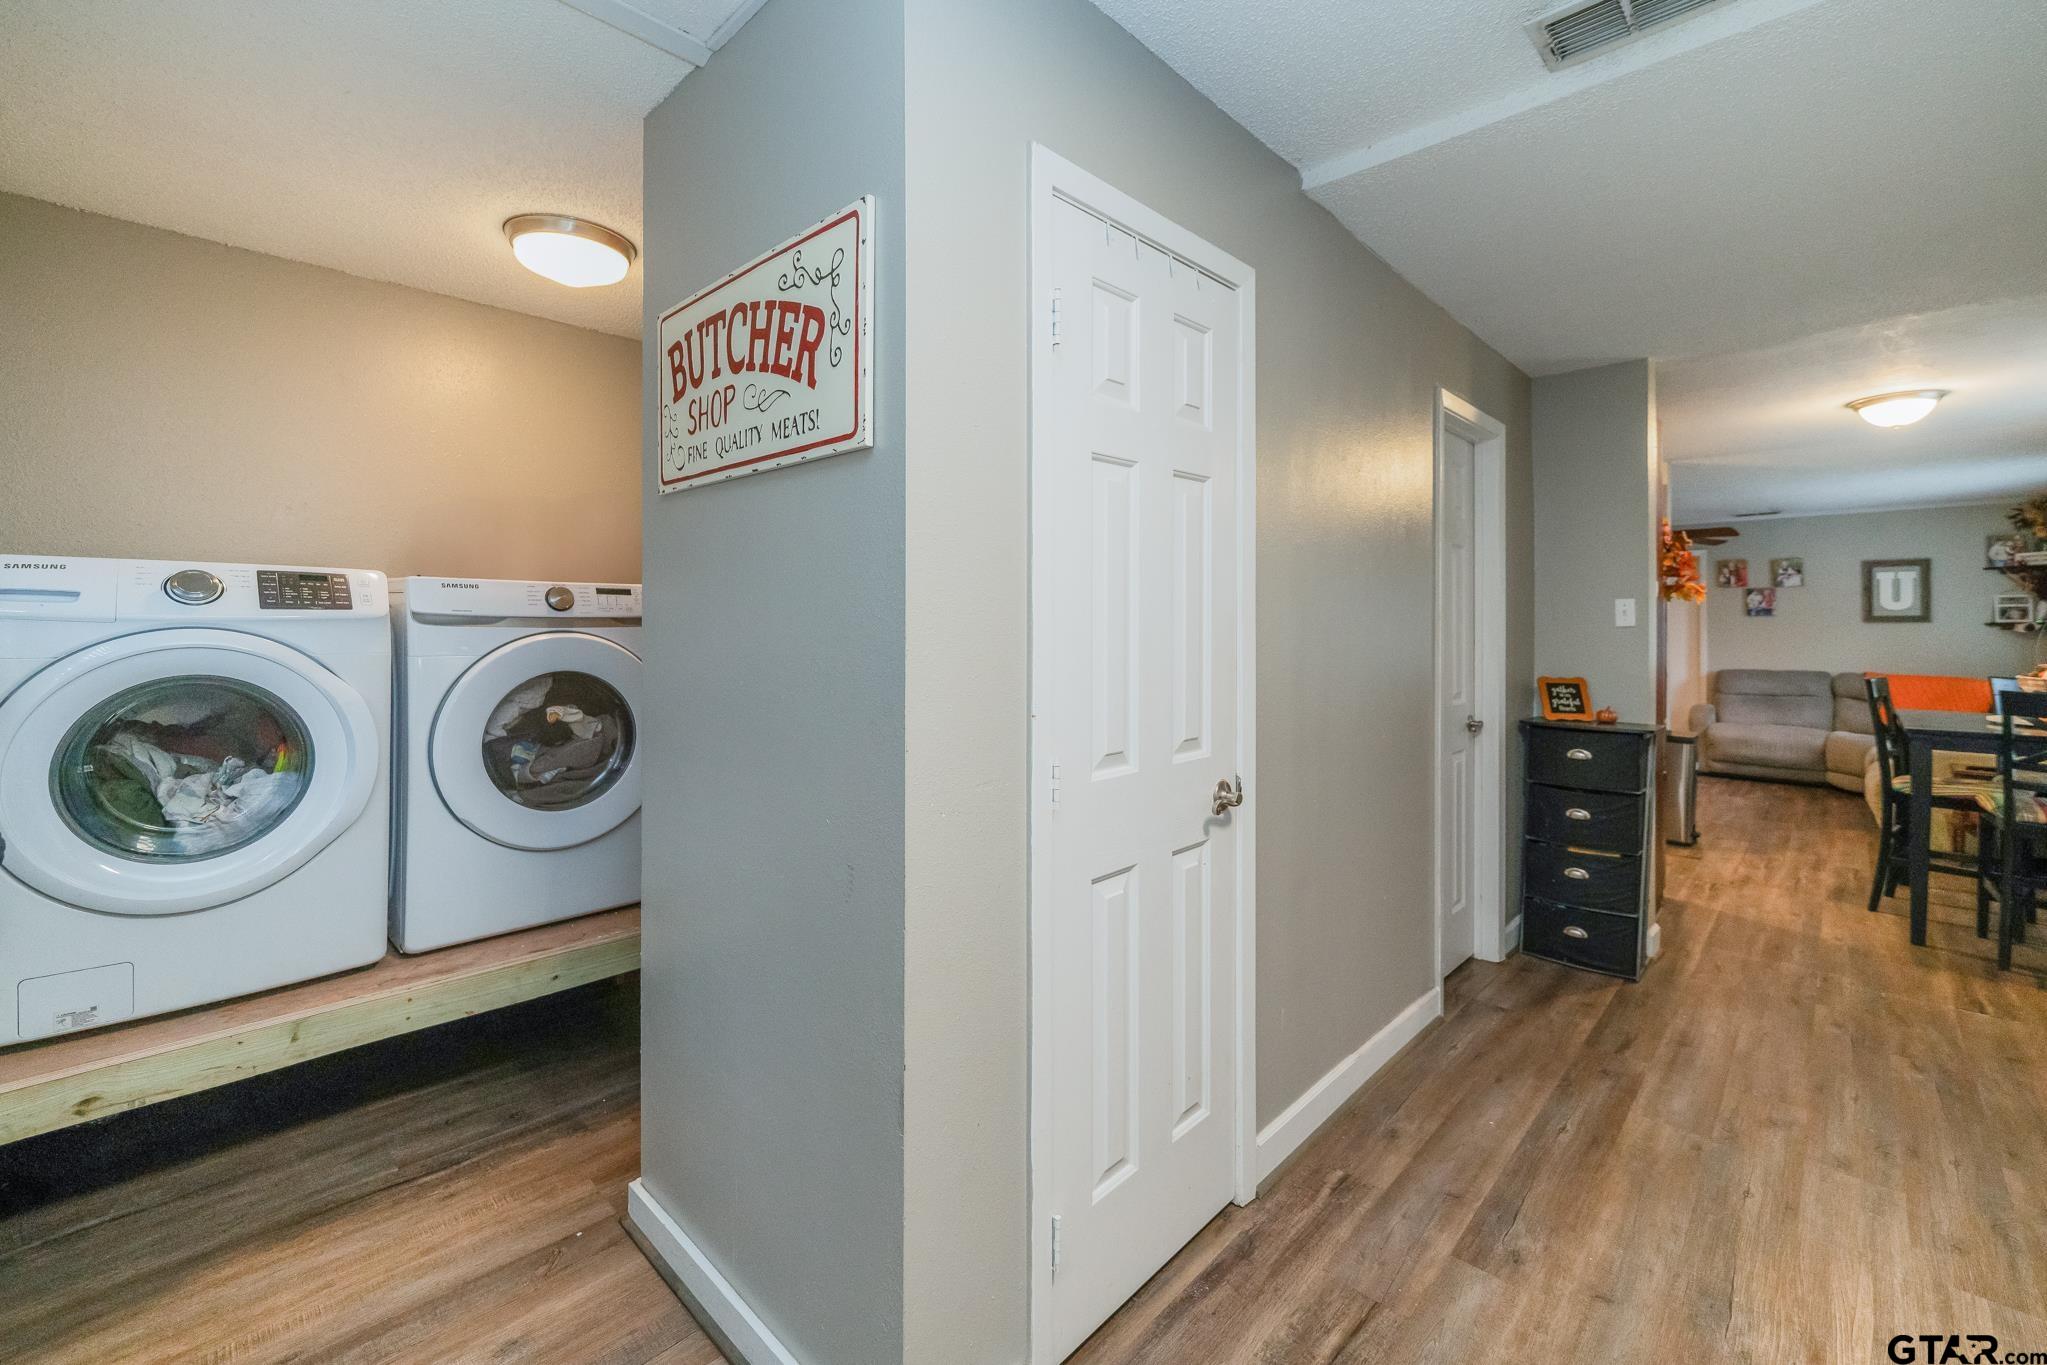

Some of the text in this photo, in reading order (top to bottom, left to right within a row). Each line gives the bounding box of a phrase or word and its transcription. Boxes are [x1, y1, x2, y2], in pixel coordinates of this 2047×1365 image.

[667, 300, 826, 404] BUTCHER
[687, 384, 736, 435] SHOP
[687, 408, 820, 465] FINE QUALITY MEATS!
[3, 563, 68, 571] SAMSUNG
[1876, 571, 1919, 610] U
